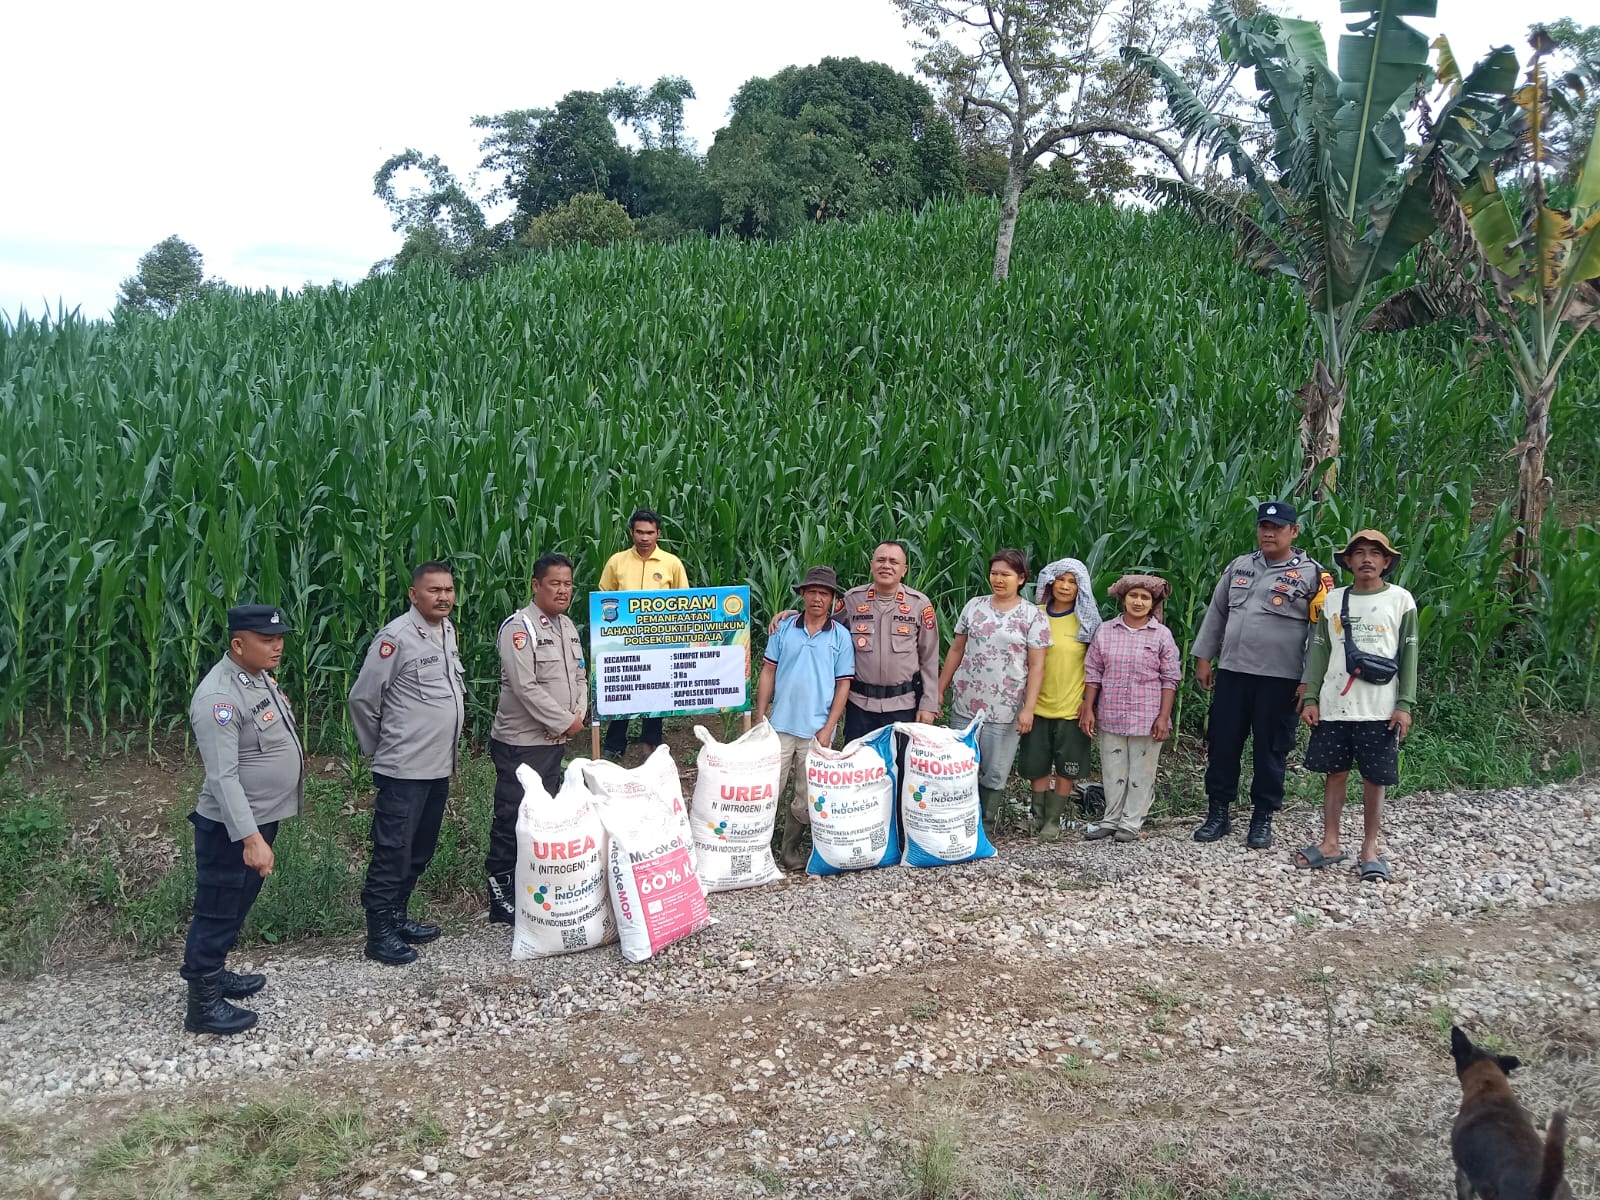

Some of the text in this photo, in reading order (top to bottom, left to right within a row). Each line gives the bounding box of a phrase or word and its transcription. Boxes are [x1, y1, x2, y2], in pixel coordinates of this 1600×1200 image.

[1276, 576, 1299, 587] POLRI
[629, 595, 717, 613] PROGRAM
[636, 612, 711, 624] PEMANFAATAN
[601, 621, 745, 637] LAHAN PRODUKTIF DI WILKUM
[624, 632, 722, 646] POLSEK BUNTURAJA
[604, 655, 641, 664] KECAMATAN
[673, 652, 699, 660] SIEMPAT
[700, 651, 720, 659] NEMPU
[604, 665, 621, 674] JENIS
[622, 664, 651, 673] TANAMAN
[673, 662, 697, 670] JAGUNG
[604, 675, 620, 683] LUAS
[621, 674, 641, 682] LAHAN
[673, 671, 678, 679] 3
[604, 684, 634, 693] PERSONIL
[635, 682, 670, 691] PENGGERAK
[674, 680, 688, 689] IPTU
[694, 679, 720, 687] SITORUS
[605, 694, 631, 702] JABATAN
[674, 689, 704, 698] KAPOLSEK
[705, 687, 739, 696] BUNTURAJA
[674, 698, 714, 707] POLRES DAIRI
[808, 767, 885, 785] PHONSKA
[720, 783, 773, 801] UREA
[931, 792, 973, 803] INDONESIA
[712, 801, 718, 810] N
[721, 804, 762, 813] (NITROGEN)
[831, 801, 879, 815] INDONESIA
[533, 835, 596, 860] UREA
[530, 862, 535, 872] N
[538, 860, 586, 875] (NITROGEN)
[641, 868, 682, 895] 60%
[545, 918, 577, 927] INDONESIA
